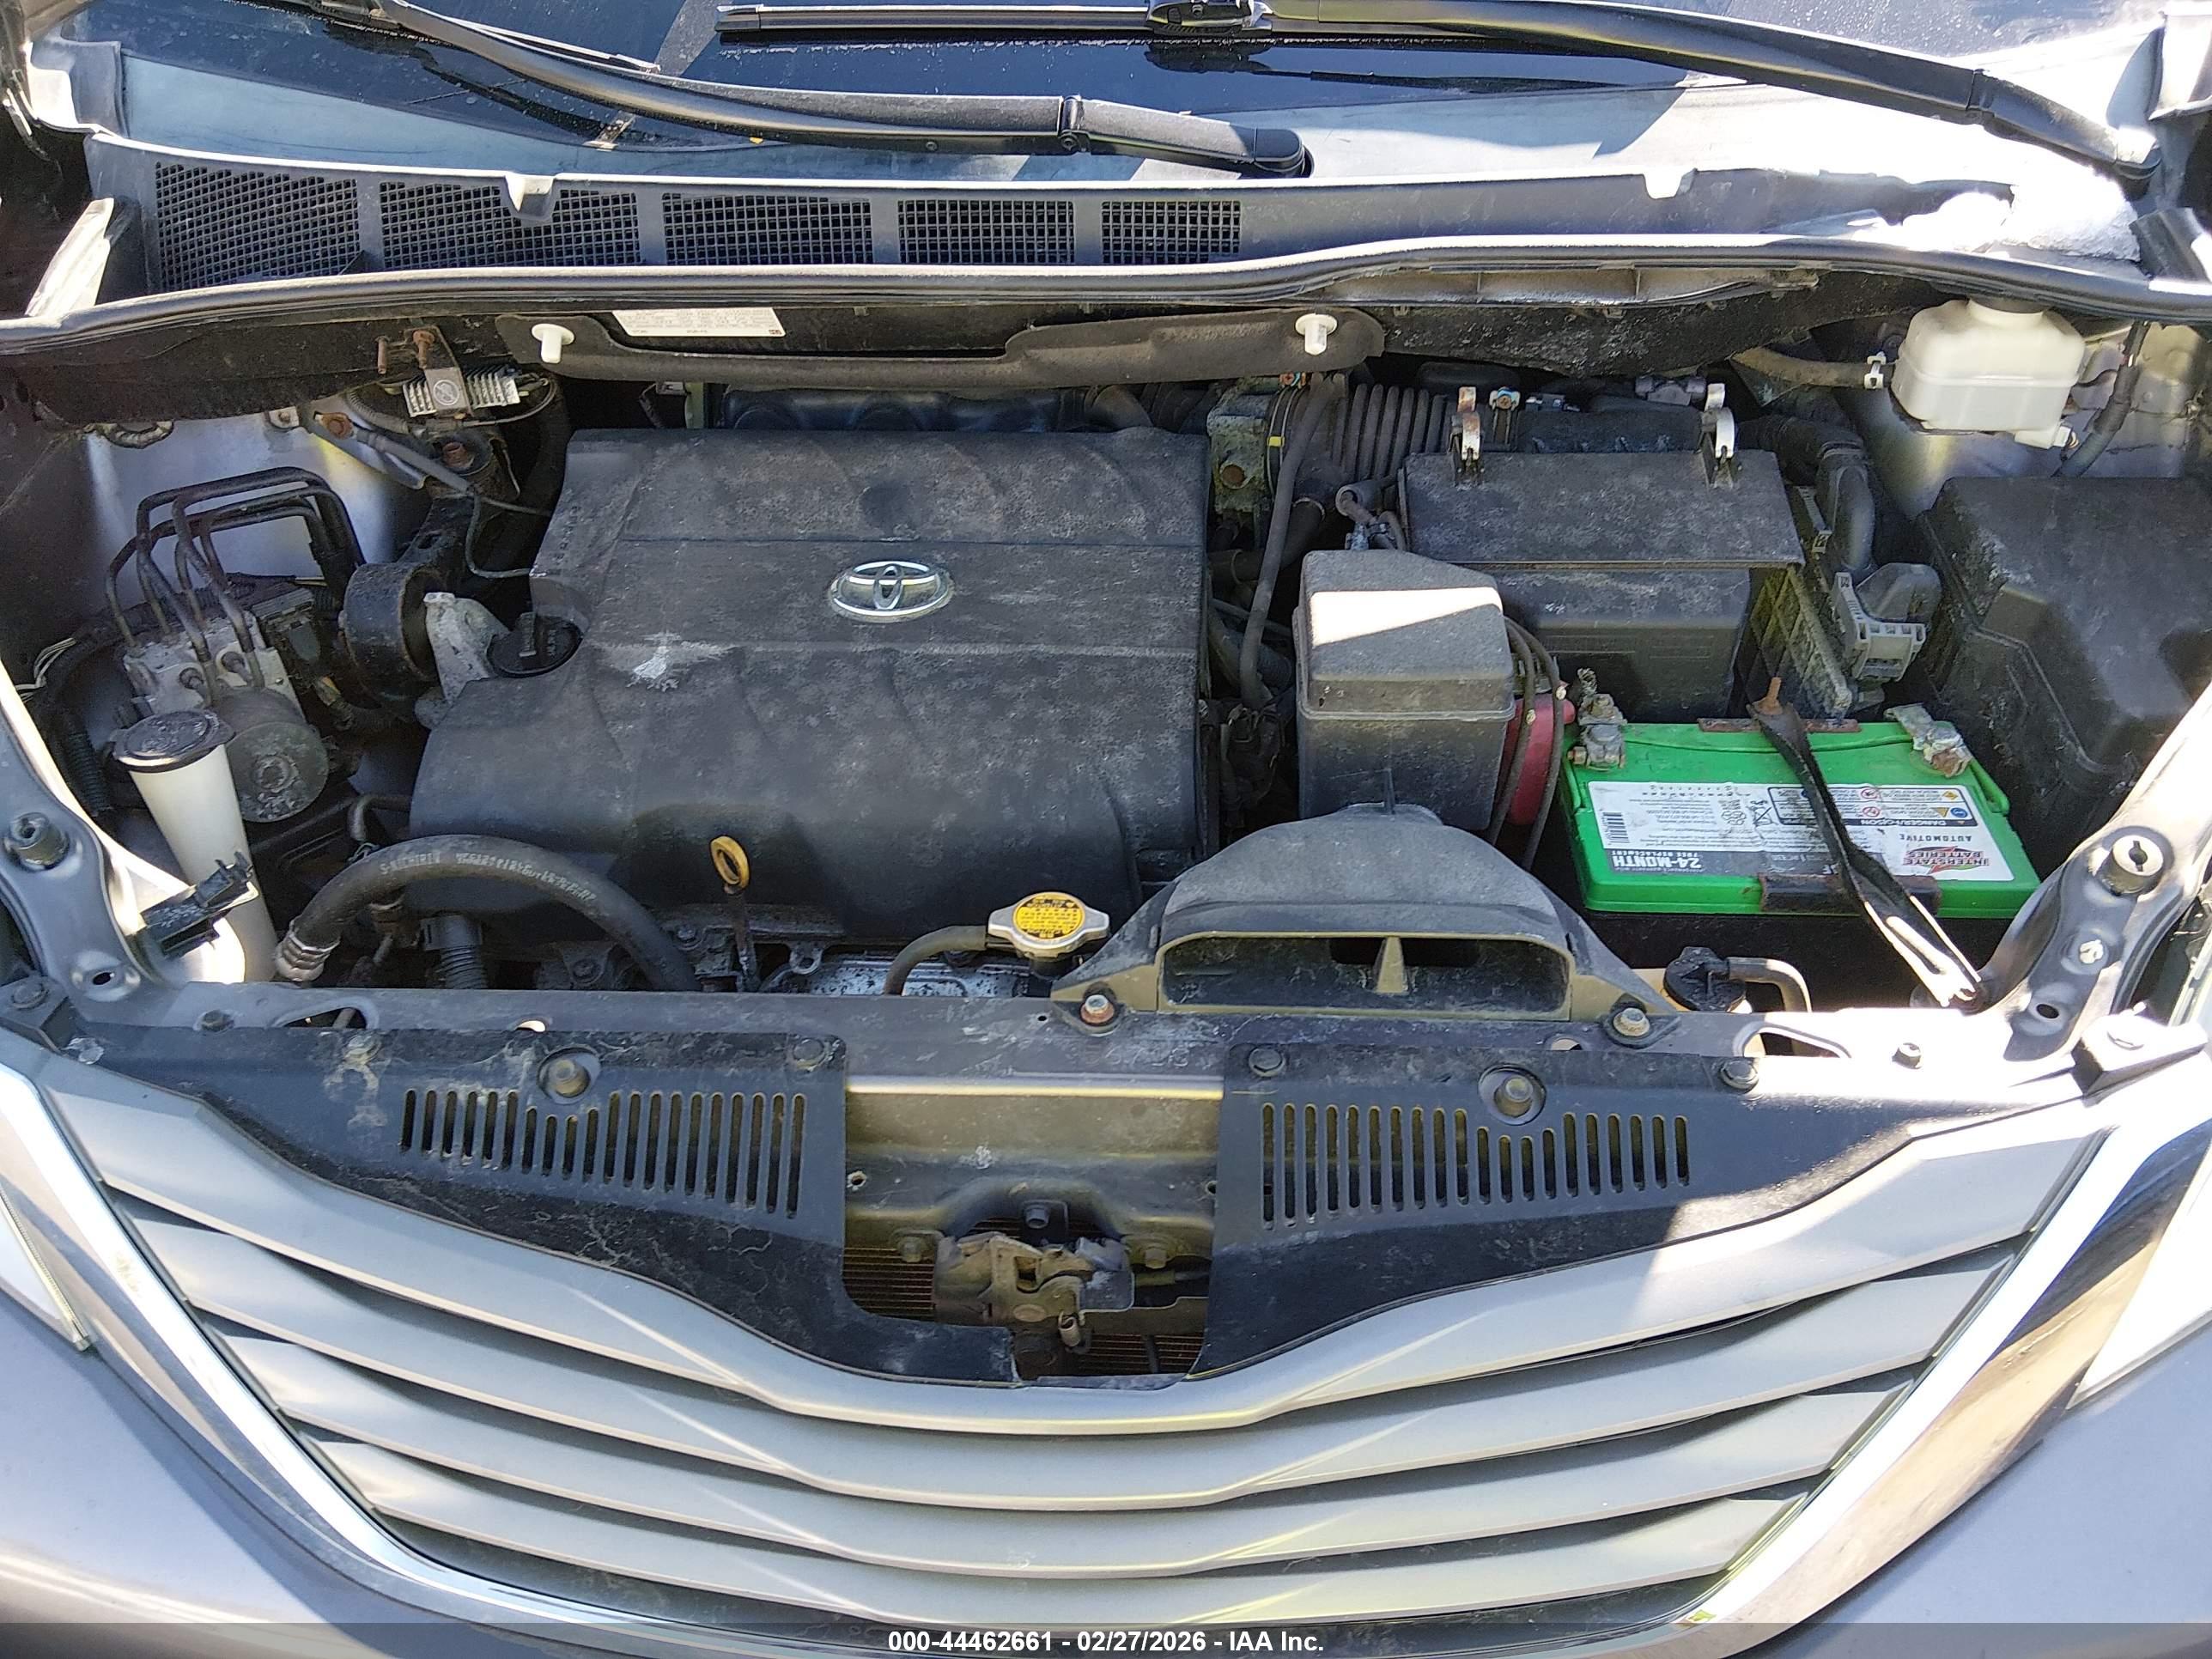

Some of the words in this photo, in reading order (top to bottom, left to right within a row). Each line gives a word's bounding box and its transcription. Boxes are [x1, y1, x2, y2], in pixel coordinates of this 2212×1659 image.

[1899, 833, 1972, 842] AUTOMOTIVE
[1612, 855, 1702, 869] 24-MONTH
[1902, 858, 1990, 866] INTERSTATE
